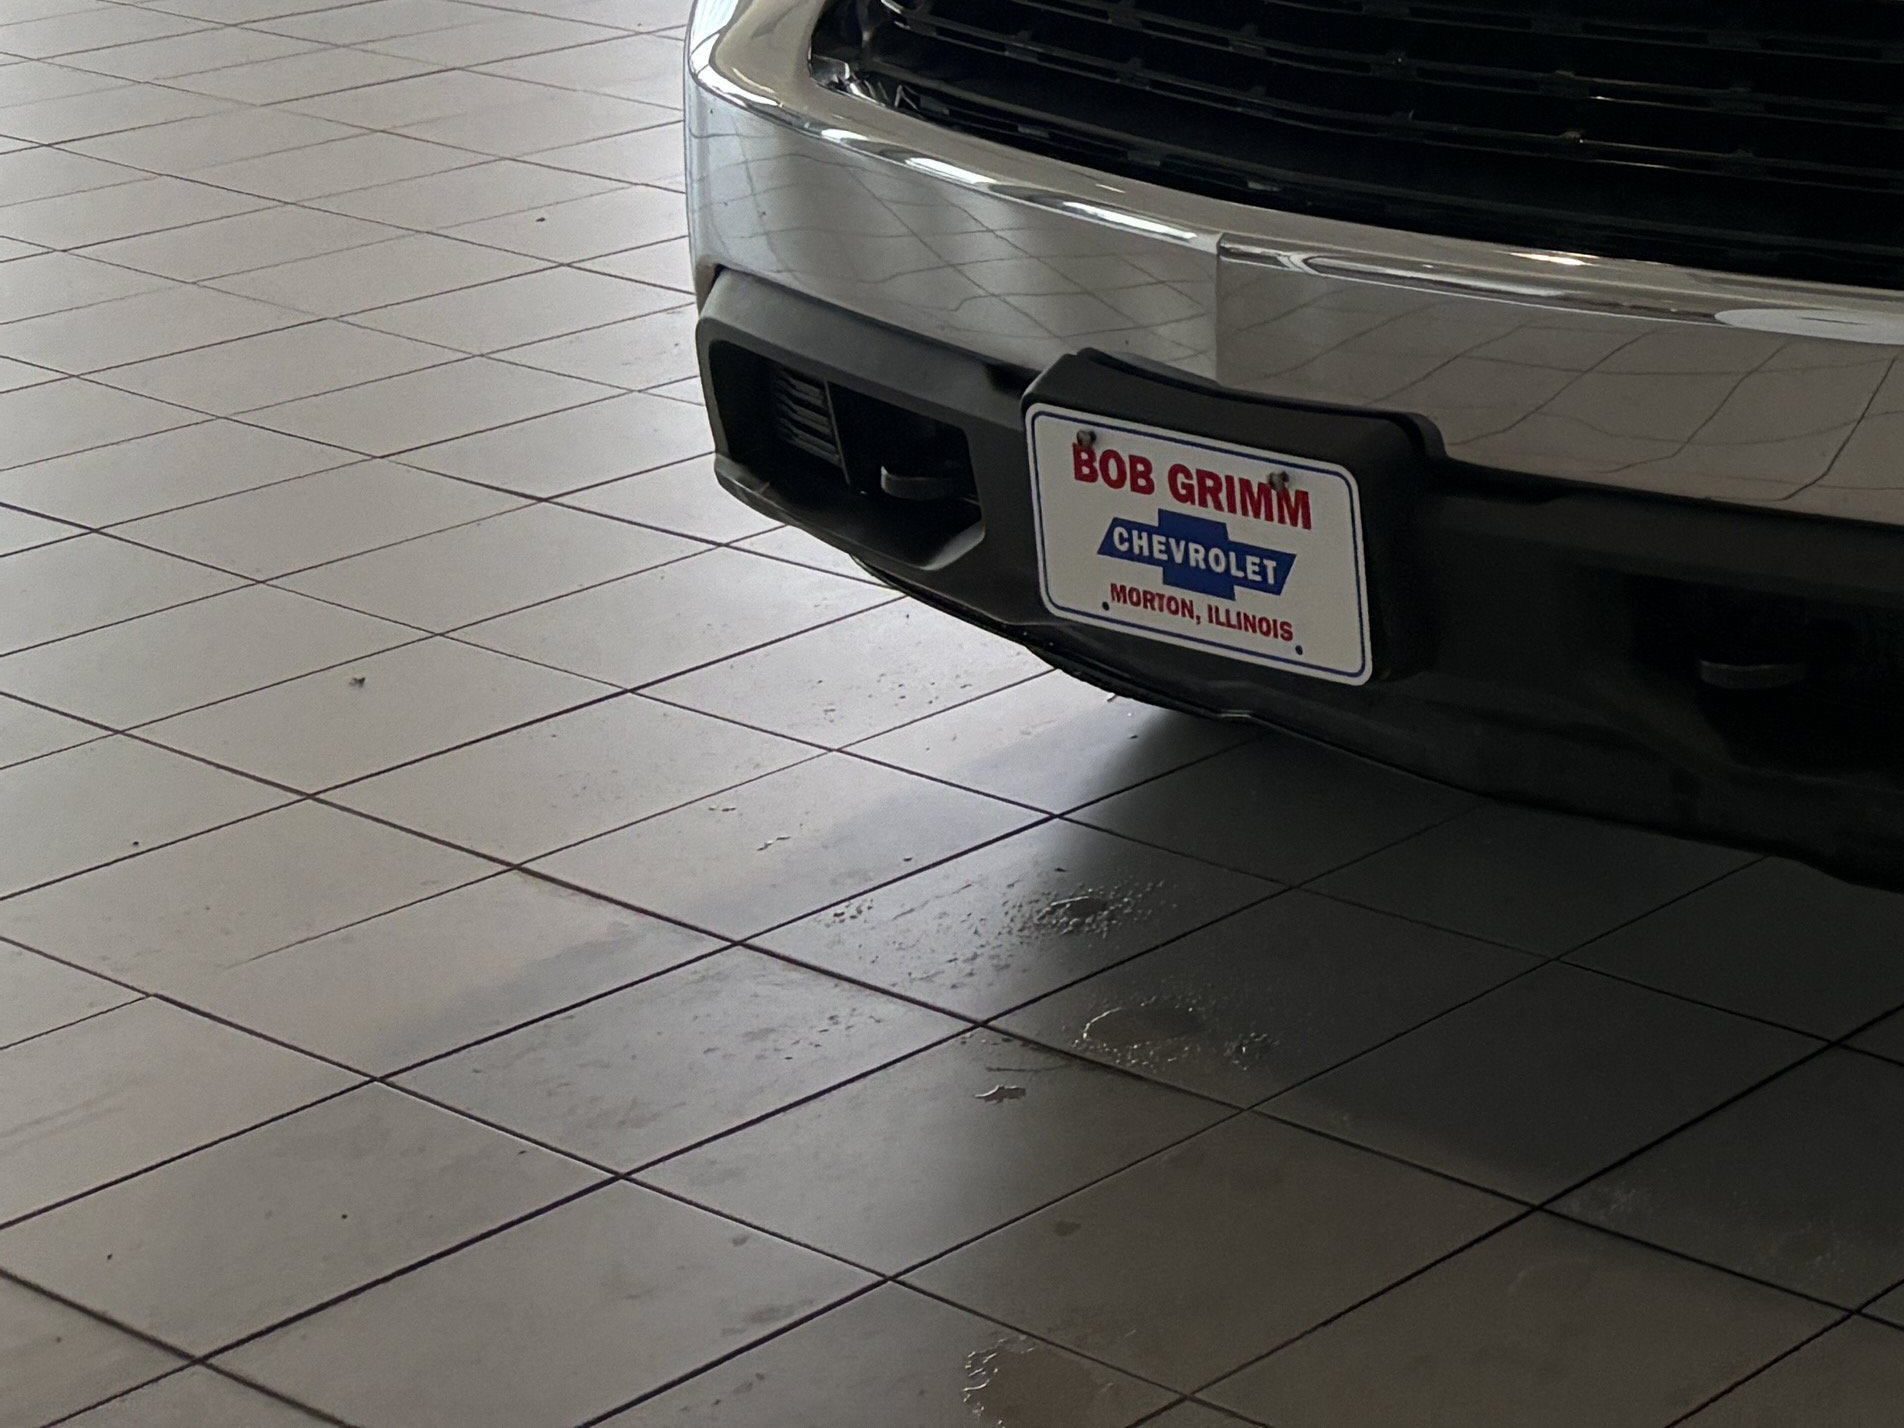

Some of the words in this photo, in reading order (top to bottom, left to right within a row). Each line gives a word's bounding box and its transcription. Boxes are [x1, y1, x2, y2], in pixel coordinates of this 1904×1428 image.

[1072, 443, 1155, 495] BOB
[1168, 464, 1312, 530] GRIMM
[1113, 526, 1277, 585] CHEVROLET
[1110, 583, 1201, 625] MORTON,
[1208, 604, 1294, 642] ILLINOIS
